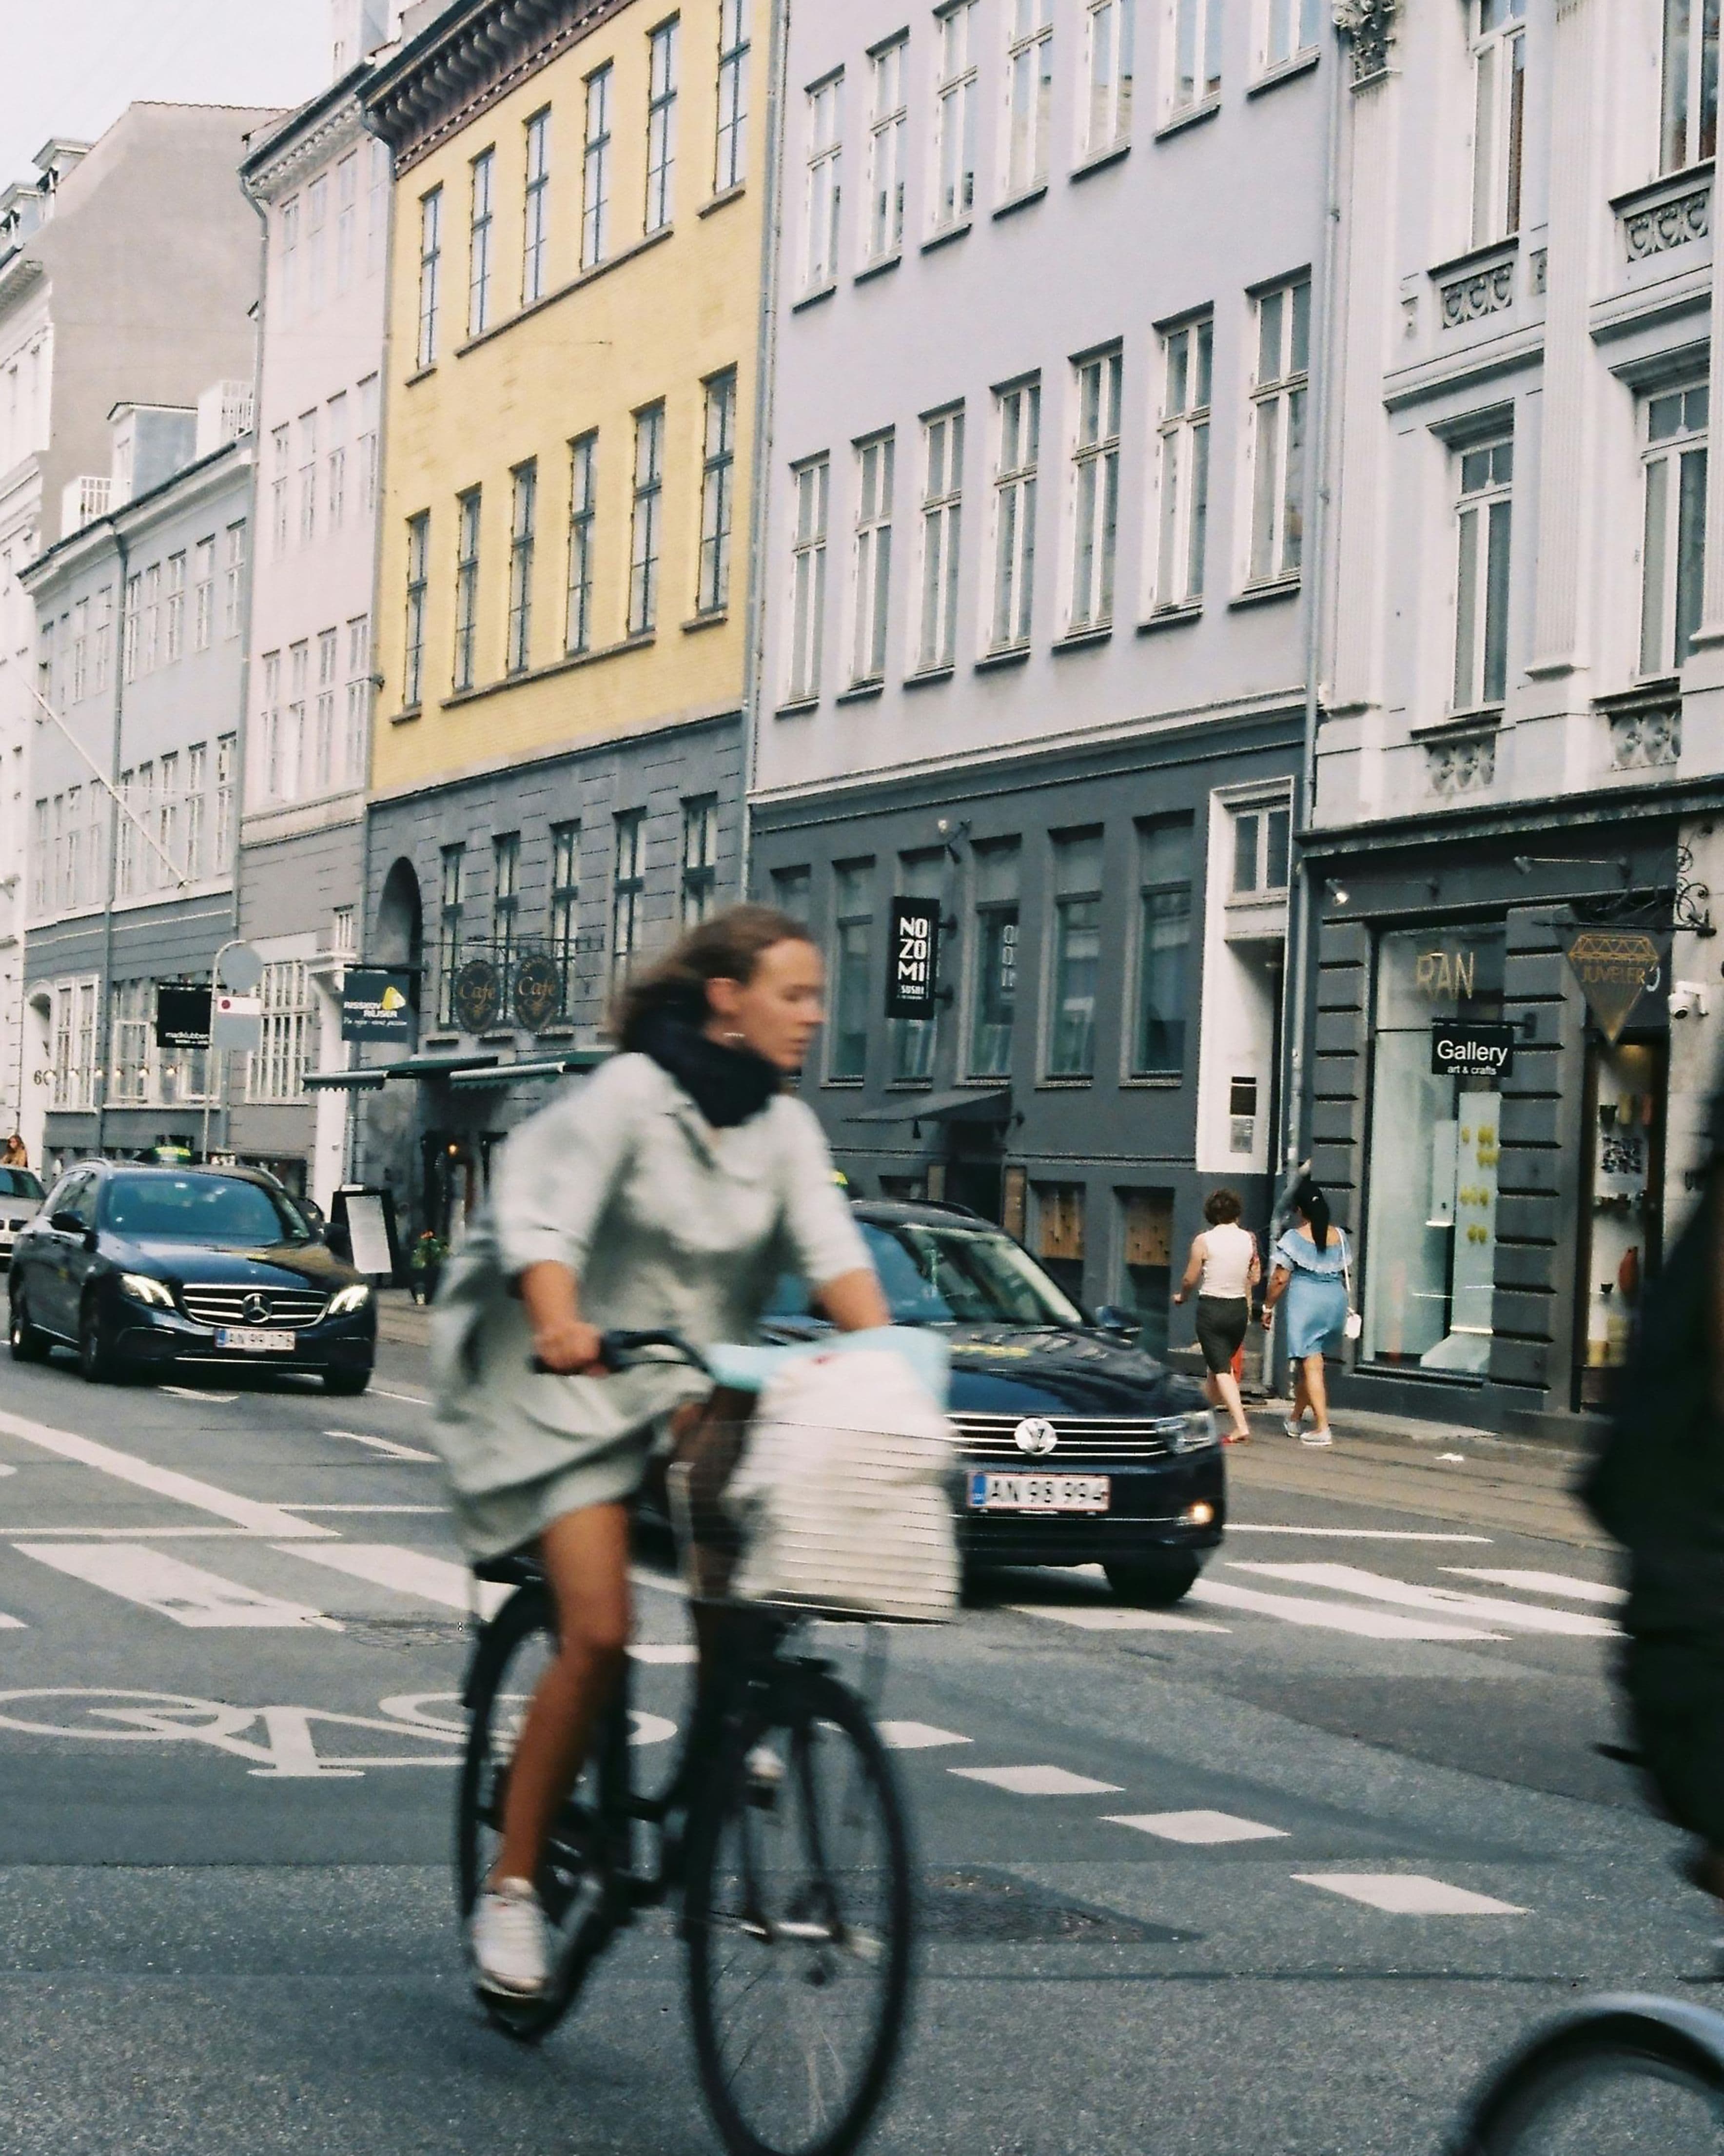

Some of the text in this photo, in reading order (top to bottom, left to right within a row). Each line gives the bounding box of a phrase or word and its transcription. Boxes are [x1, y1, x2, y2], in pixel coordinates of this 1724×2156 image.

[900, 917, 928, 939] NO
[899, 939, 927, 960] ZO
[898, 960, 925, 982] MI
[1437, 1039, 1508, 1066] Gallery
[1447, 1065, 1497, 1076] art & crafts
[990, 1480, 1020, 1502] AN
